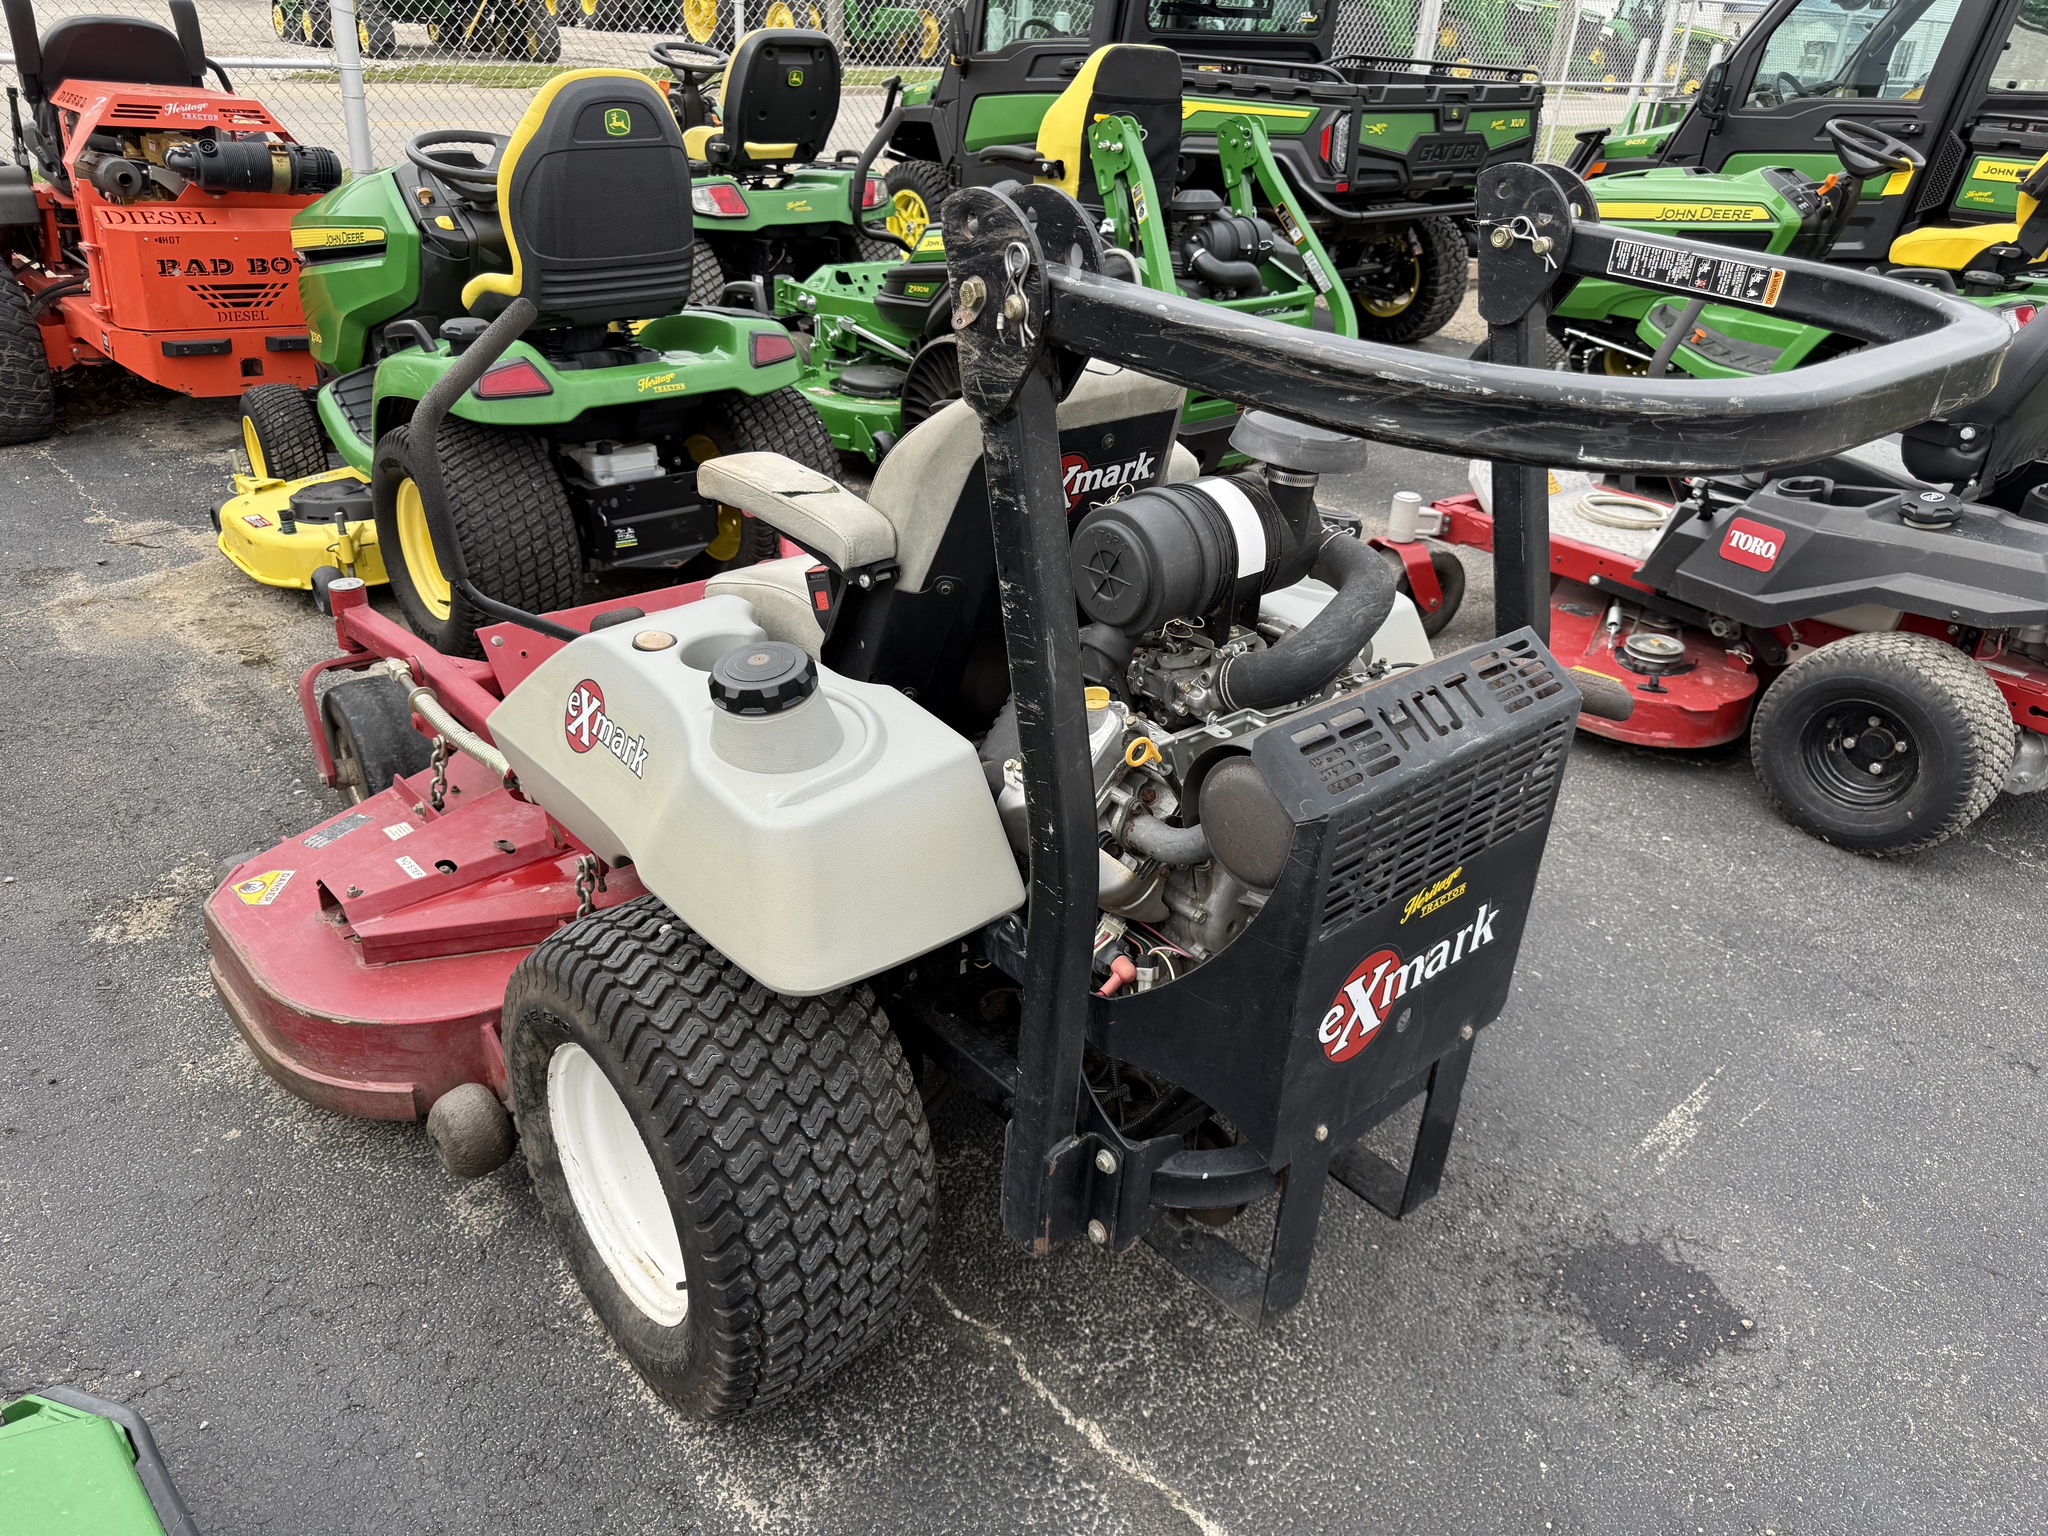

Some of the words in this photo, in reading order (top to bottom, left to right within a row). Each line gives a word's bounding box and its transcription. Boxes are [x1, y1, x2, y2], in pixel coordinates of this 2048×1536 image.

[164, 102, 208, 116] Heritage
[181, 113, 219, 121] TRACTOR
[1417, 142, 1480, 163] GATOR
[1983, 166, 2015, 176] JOHN
[102, 210, 217, 225] DIESEL
[1655, 207, 1698, 219] JOHN
[1700, 207, 1754, 219] DEERE
[162, 236, 181, 245] HOT
[325, 233, 342, 246] JOHN
[342, 231, 365, 243] DEERE
[925, 240, 940, 248] JOHN
[157, 258, 234, 277] BAD
[217, 310, 269, 323] DIESEL
[637, 372, 676, 392] Heritage
[1729, 529, 1777, 559] TORO
[1377, 672, 1487, 751] HOT
[566, 685, 649, 779] eXmark
[400, 857, 412, 868] NO
[407, 864, 423, 878] STEP
[264, 871, 291, 903] DANGER
[1400, 866, 1463, 924] Heritage
[1420, 882, 1467, 918] TRACTOR
[1318, 904, 1501, 1059] eXmark
